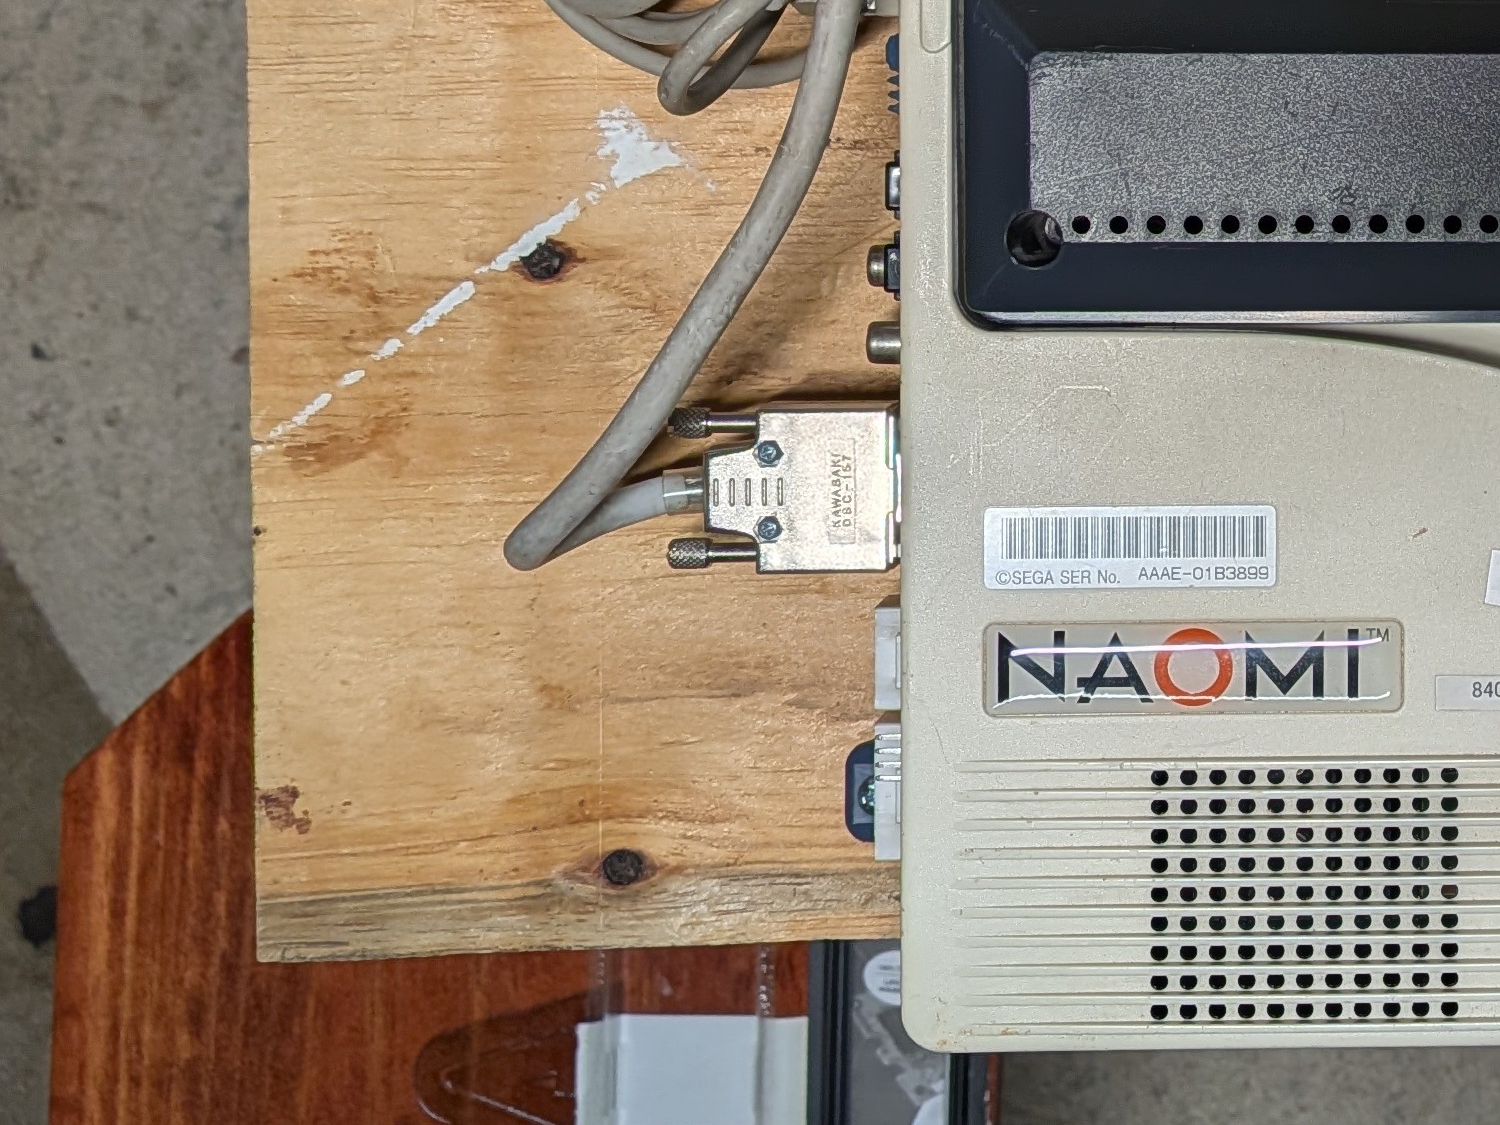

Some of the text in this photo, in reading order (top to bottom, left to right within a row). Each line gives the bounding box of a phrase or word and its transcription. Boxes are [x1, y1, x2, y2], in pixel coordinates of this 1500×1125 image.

[1060, 569, 1091, 584] SER
[1097, 569, 1121, 584] No.
[1138, 566, 1269, 582] AAAE-01B3899
[997, 628, 1360, 707] NAOMI
